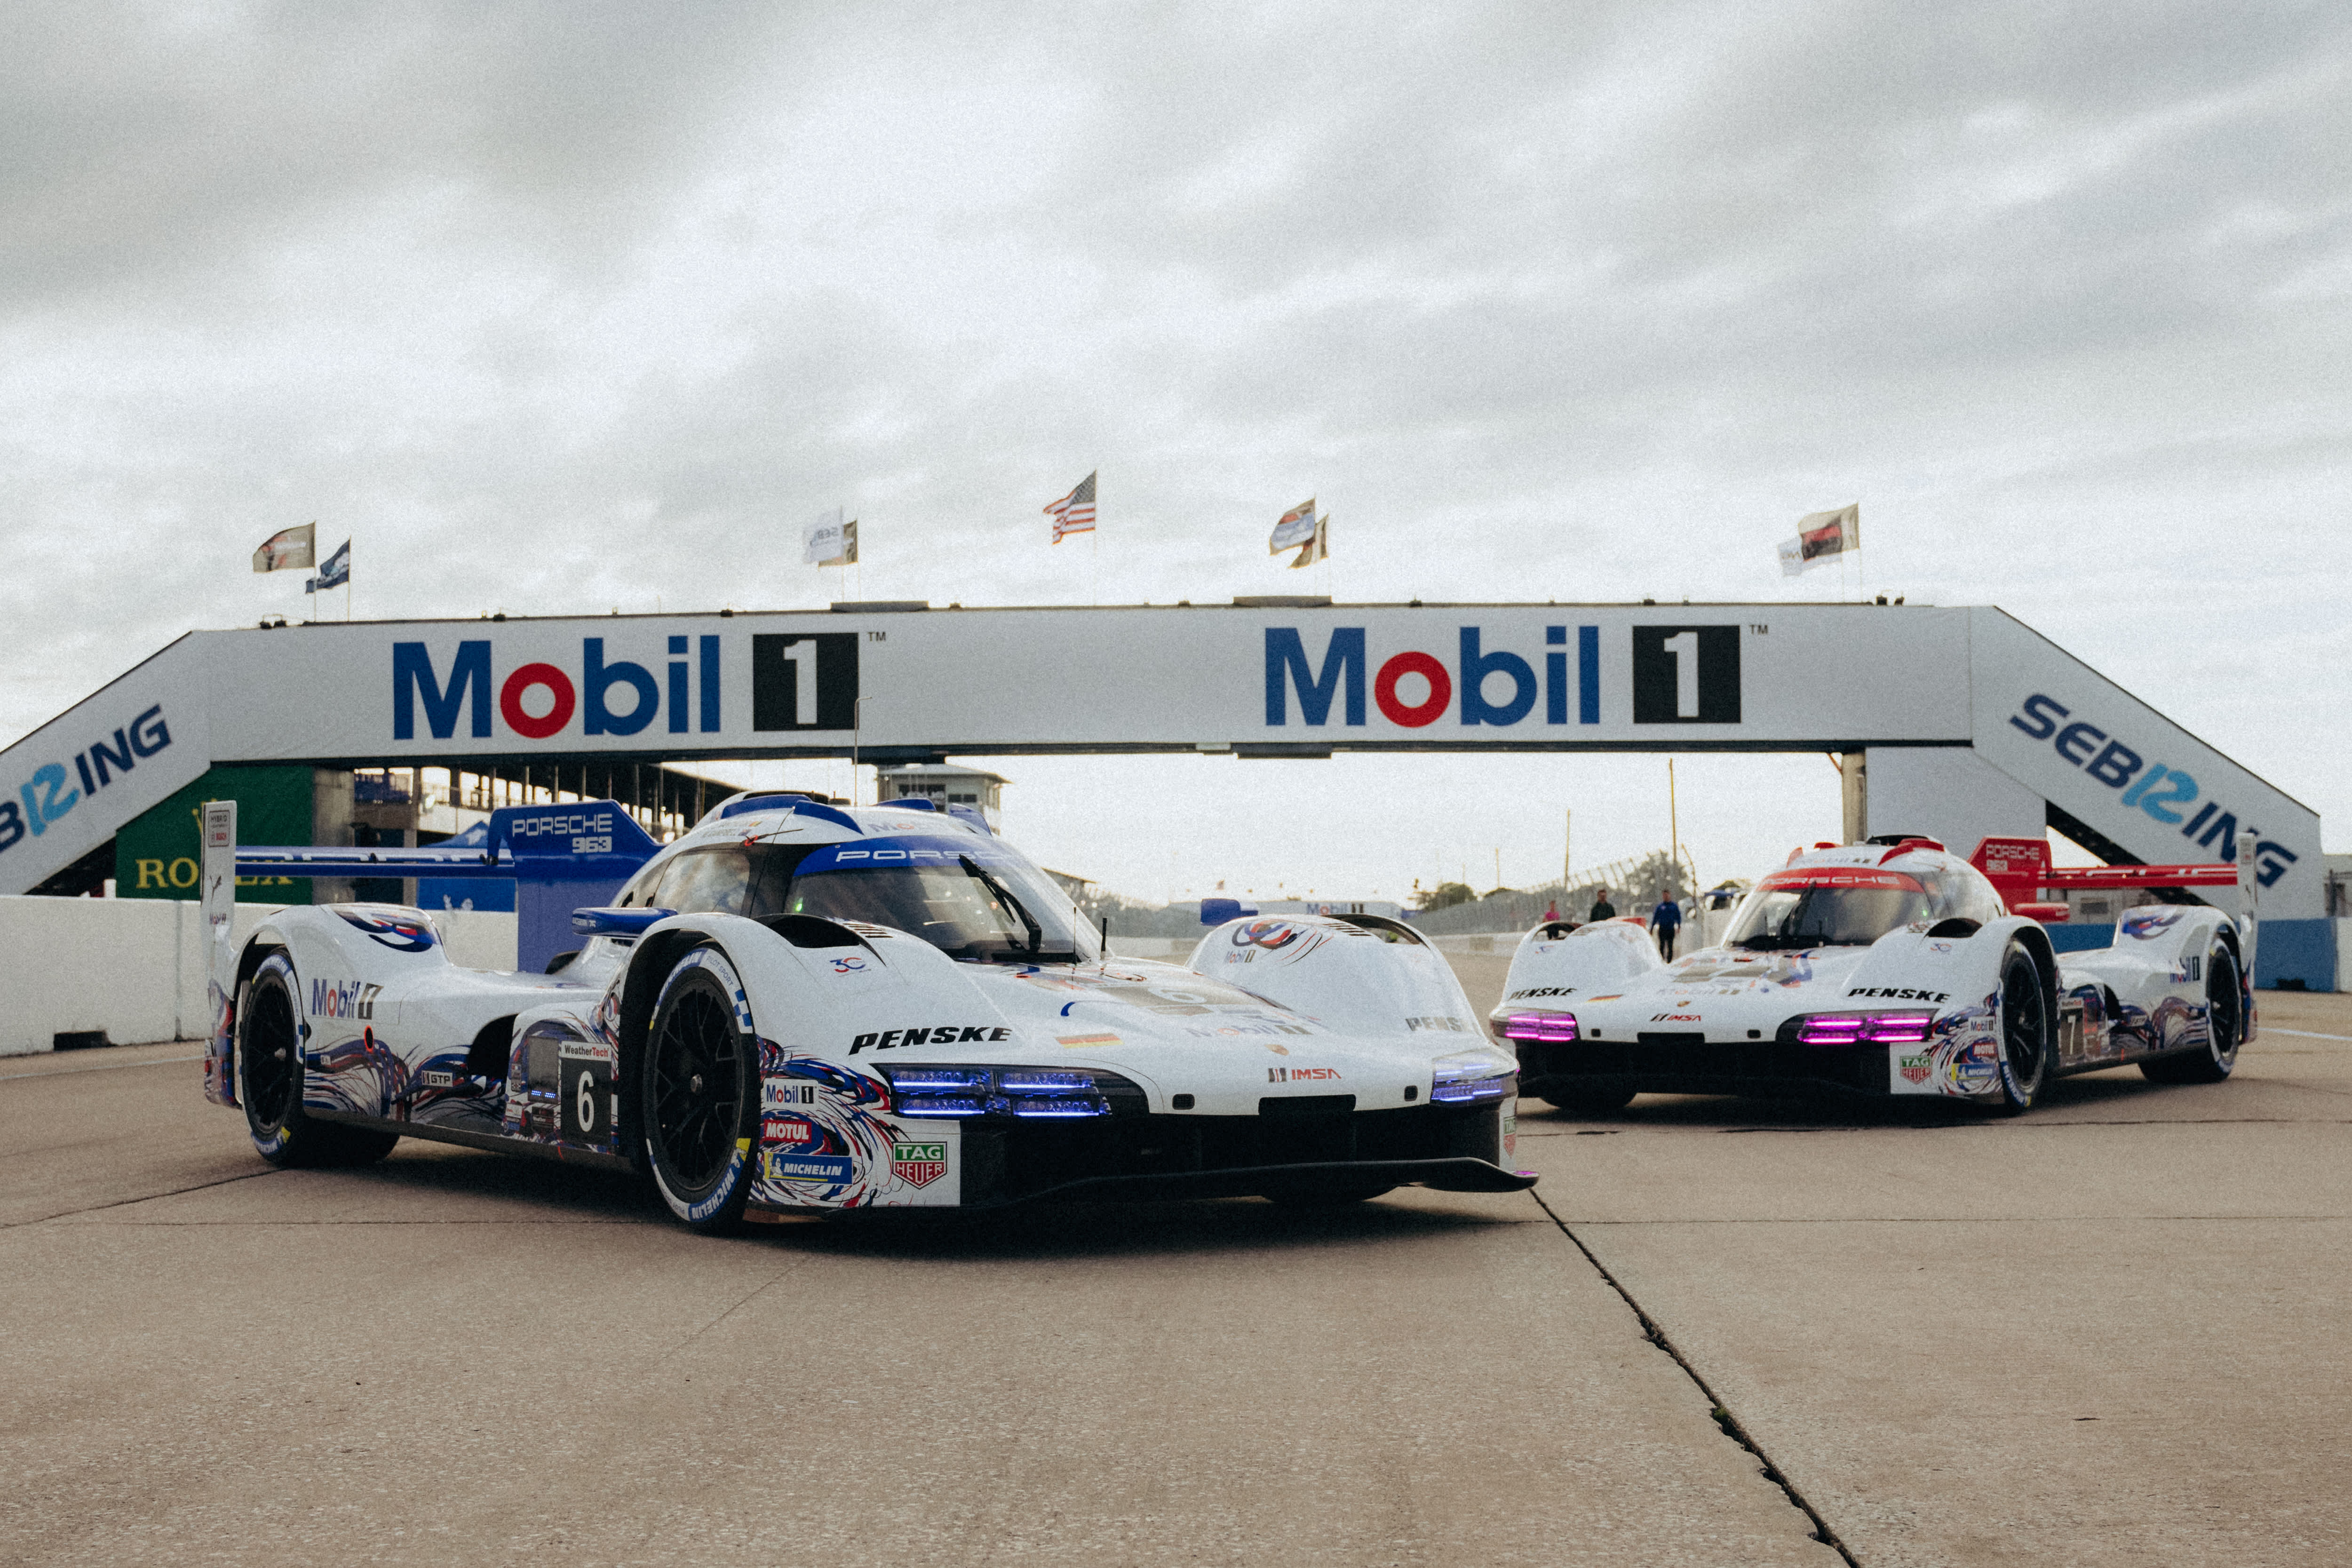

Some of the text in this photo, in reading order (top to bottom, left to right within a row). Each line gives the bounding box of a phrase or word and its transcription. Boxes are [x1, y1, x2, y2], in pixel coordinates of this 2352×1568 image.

[1265, 625, 1768, 728] Mobil 1 TM
[393, 632, 886, 740] Mobil 1 TM
[512, 813, 612, 837] PORSCHE
[572, 836, 612, 854] 963
[1986, 844, 2040, 860] PORSCHE
[718, 965, 734, 986] SPORT
[312, 978, 361, 1019] Mobil
[1507, 987, 1577, 1002] PENSKE
[1848, 988, 1951, 1003] PENSKE
[848, 1027, 1013, 1056] PENSKE
[2068, 1015, 2076, 1055] 7
[564, 1043, 609, 1058] WeatherTech
[1902, 1058, 1930, 1067] TAG
[431, 1071, 451, 1084] GTP
[1291, 1068, 1342, 1080] IMSA
[1903, 1068, 1931, 1079] HEUER
[577, 1070, 595, 1132] 6
[766, 1084, 798, 1104] Mobil
[766, 1122, 809, 1140] MOTUL
[897, 1144, 942, 1160] TAG
[783, 1162, 843, 1177] MICHELIN
[896, 1163, 942, 1183] HEUER
[691, 1168, 736, 1219] MICHELIN
